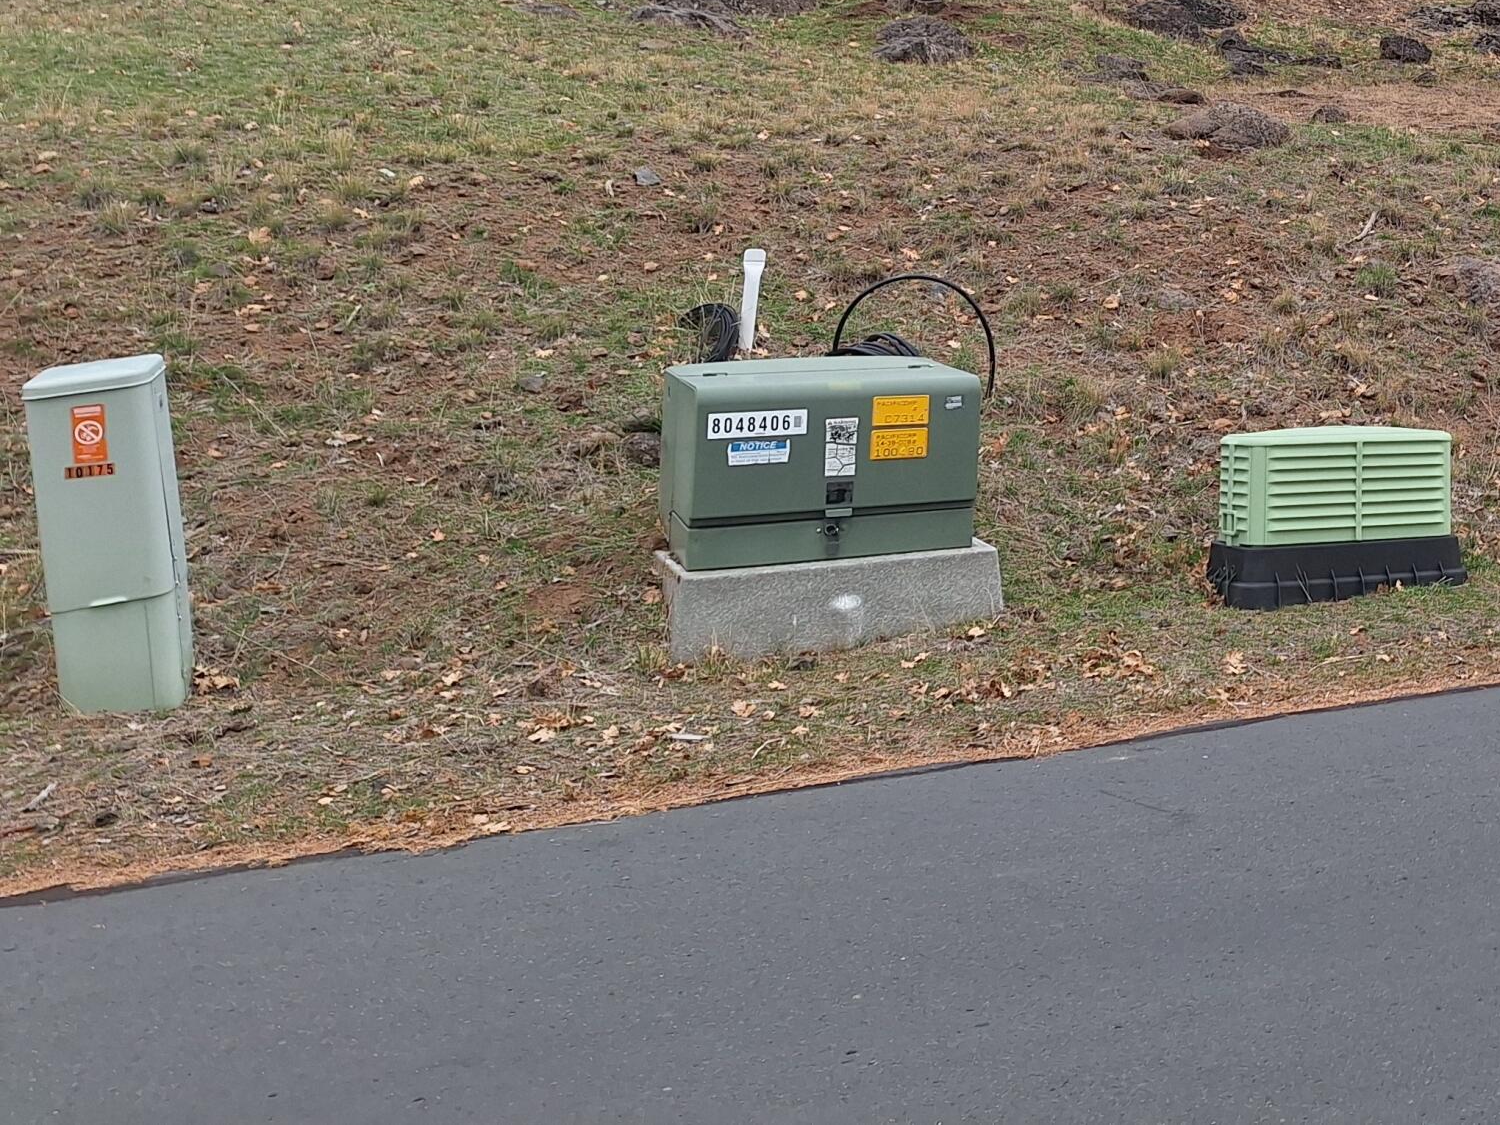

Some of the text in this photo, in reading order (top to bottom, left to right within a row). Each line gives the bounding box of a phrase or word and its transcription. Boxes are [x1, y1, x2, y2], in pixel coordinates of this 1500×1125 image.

[712, 415, 790, 434] 8048406
[739, 441, 778, 451] NOTICE
[67, 464, 114, 478] 10175
